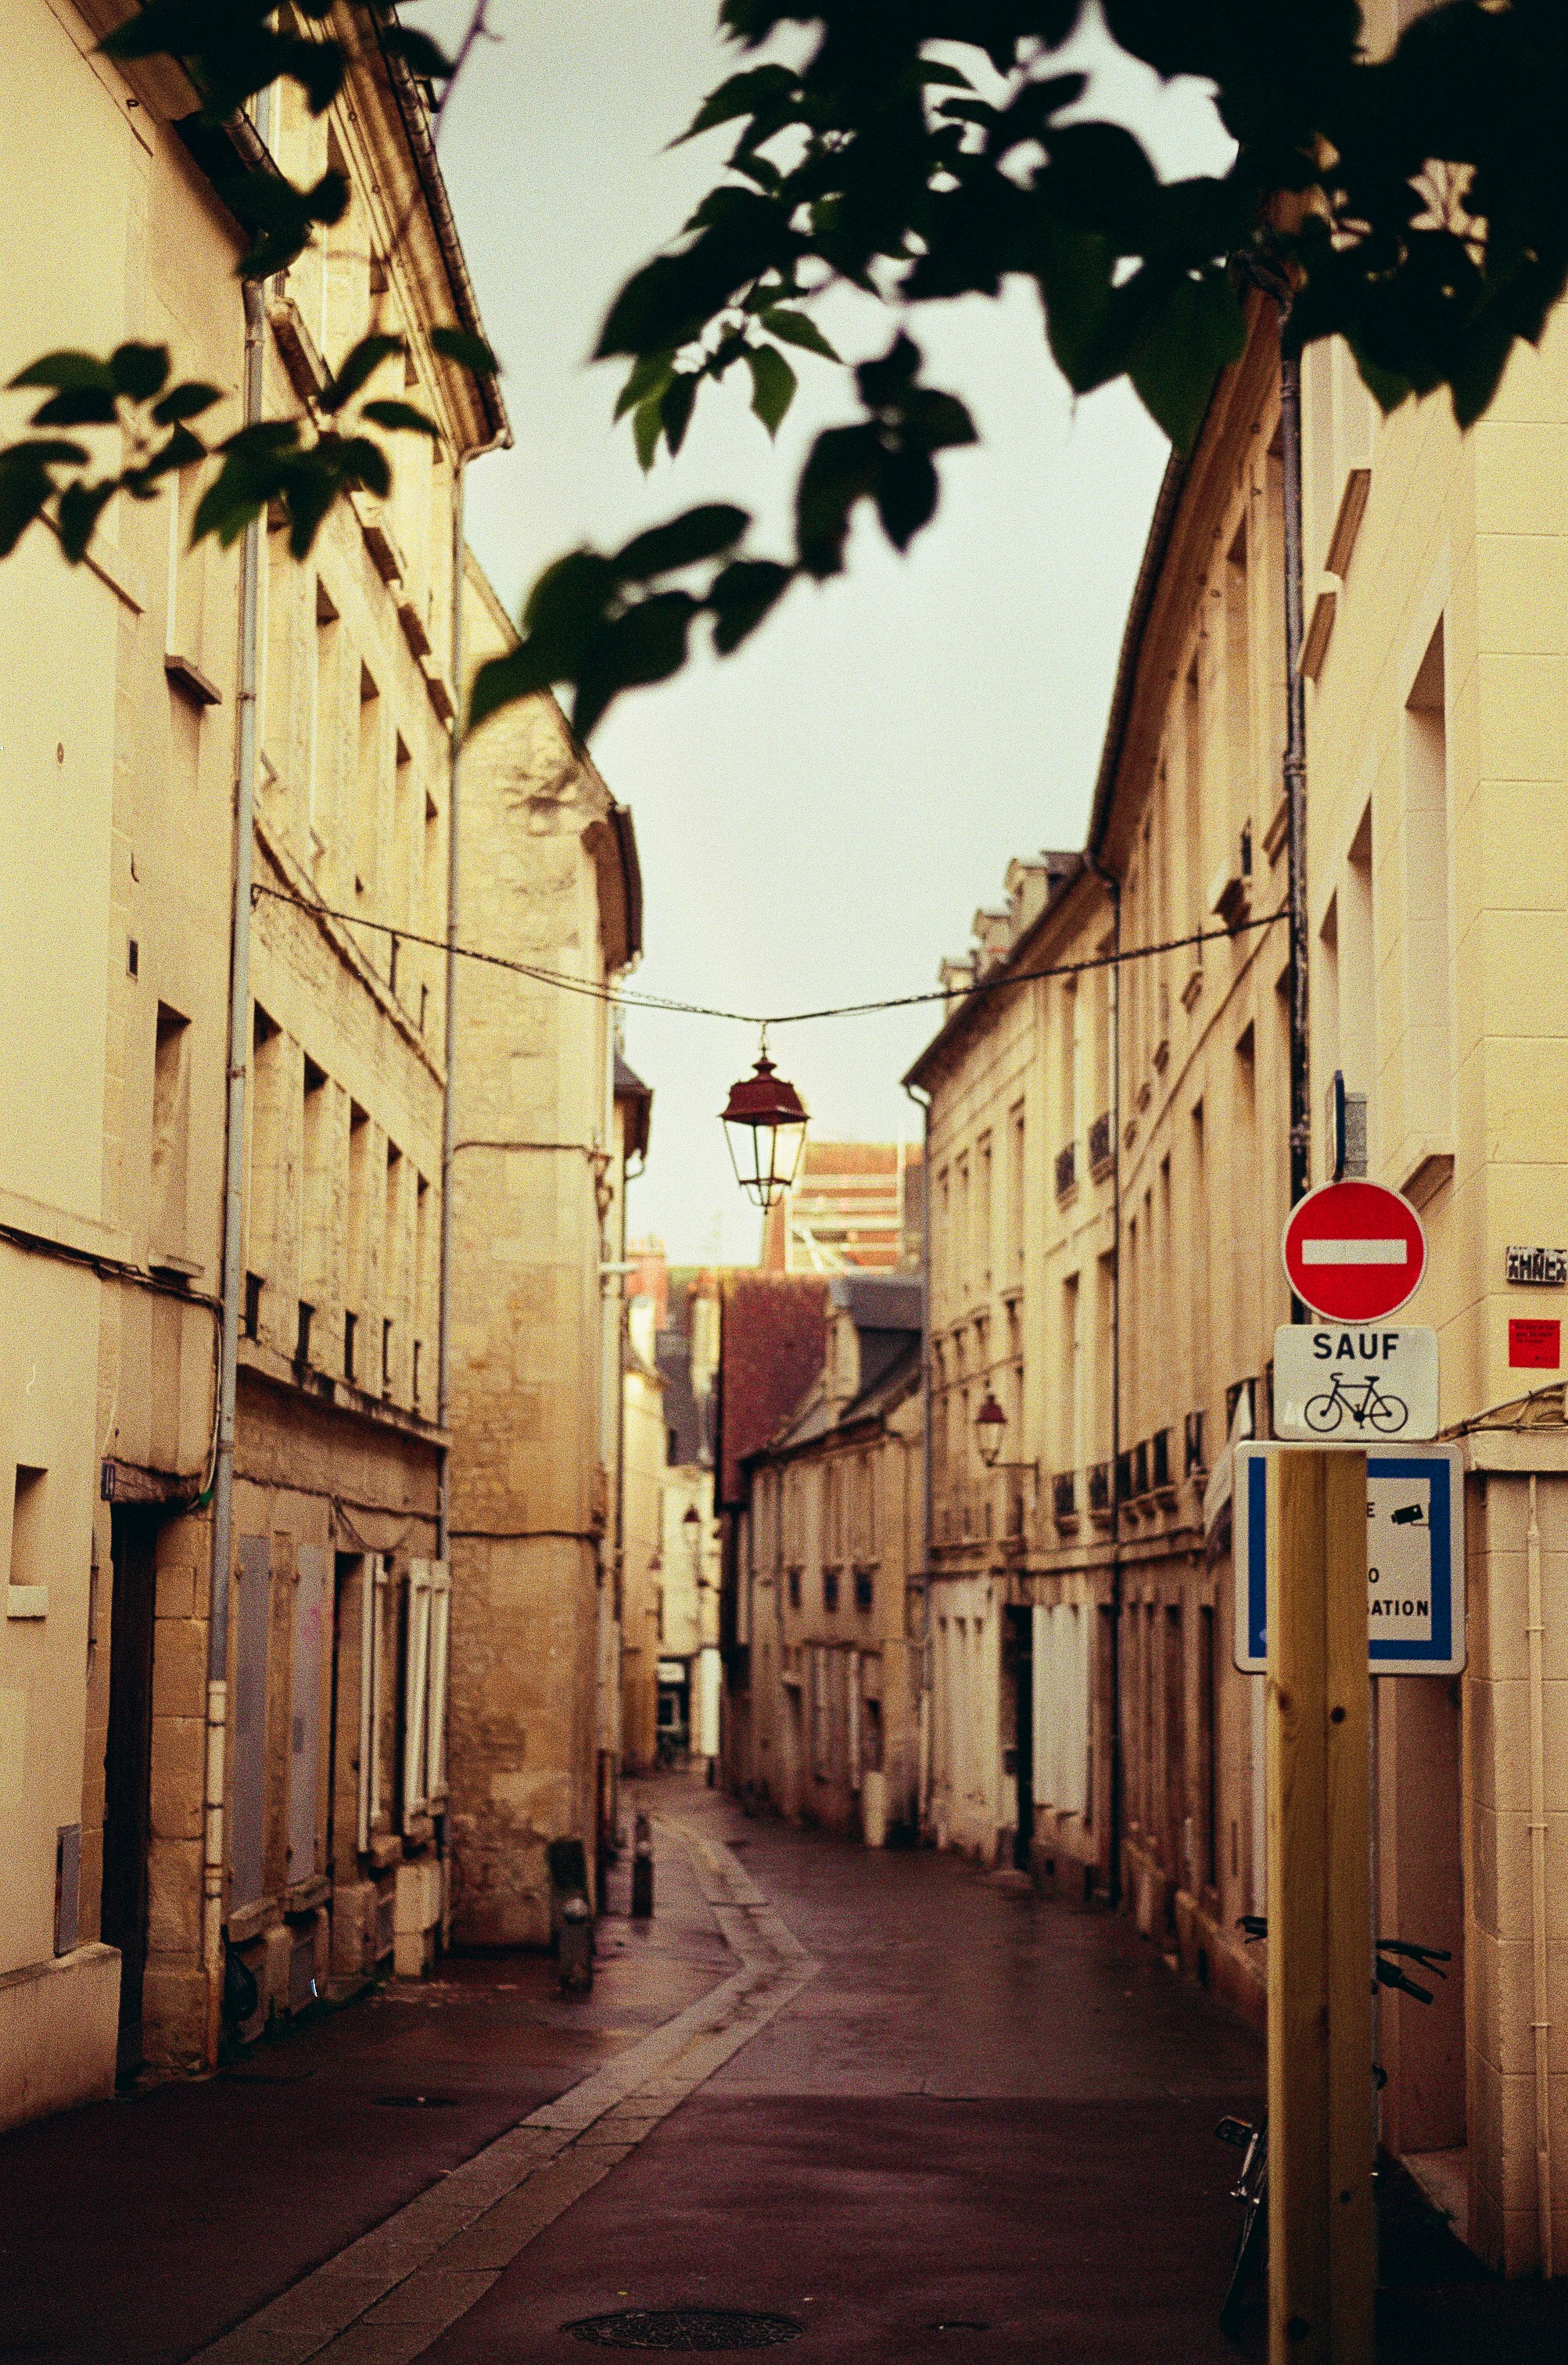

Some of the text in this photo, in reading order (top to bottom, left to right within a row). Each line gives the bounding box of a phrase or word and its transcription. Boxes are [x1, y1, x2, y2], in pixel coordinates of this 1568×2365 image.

[1313, 1333, 1399, 1360] SAUF
[1367, 1502, 1376, 1518] E
[1369, 1567, 1380, 1584] O
[1369, 1599, 1429, 1617] ATION
